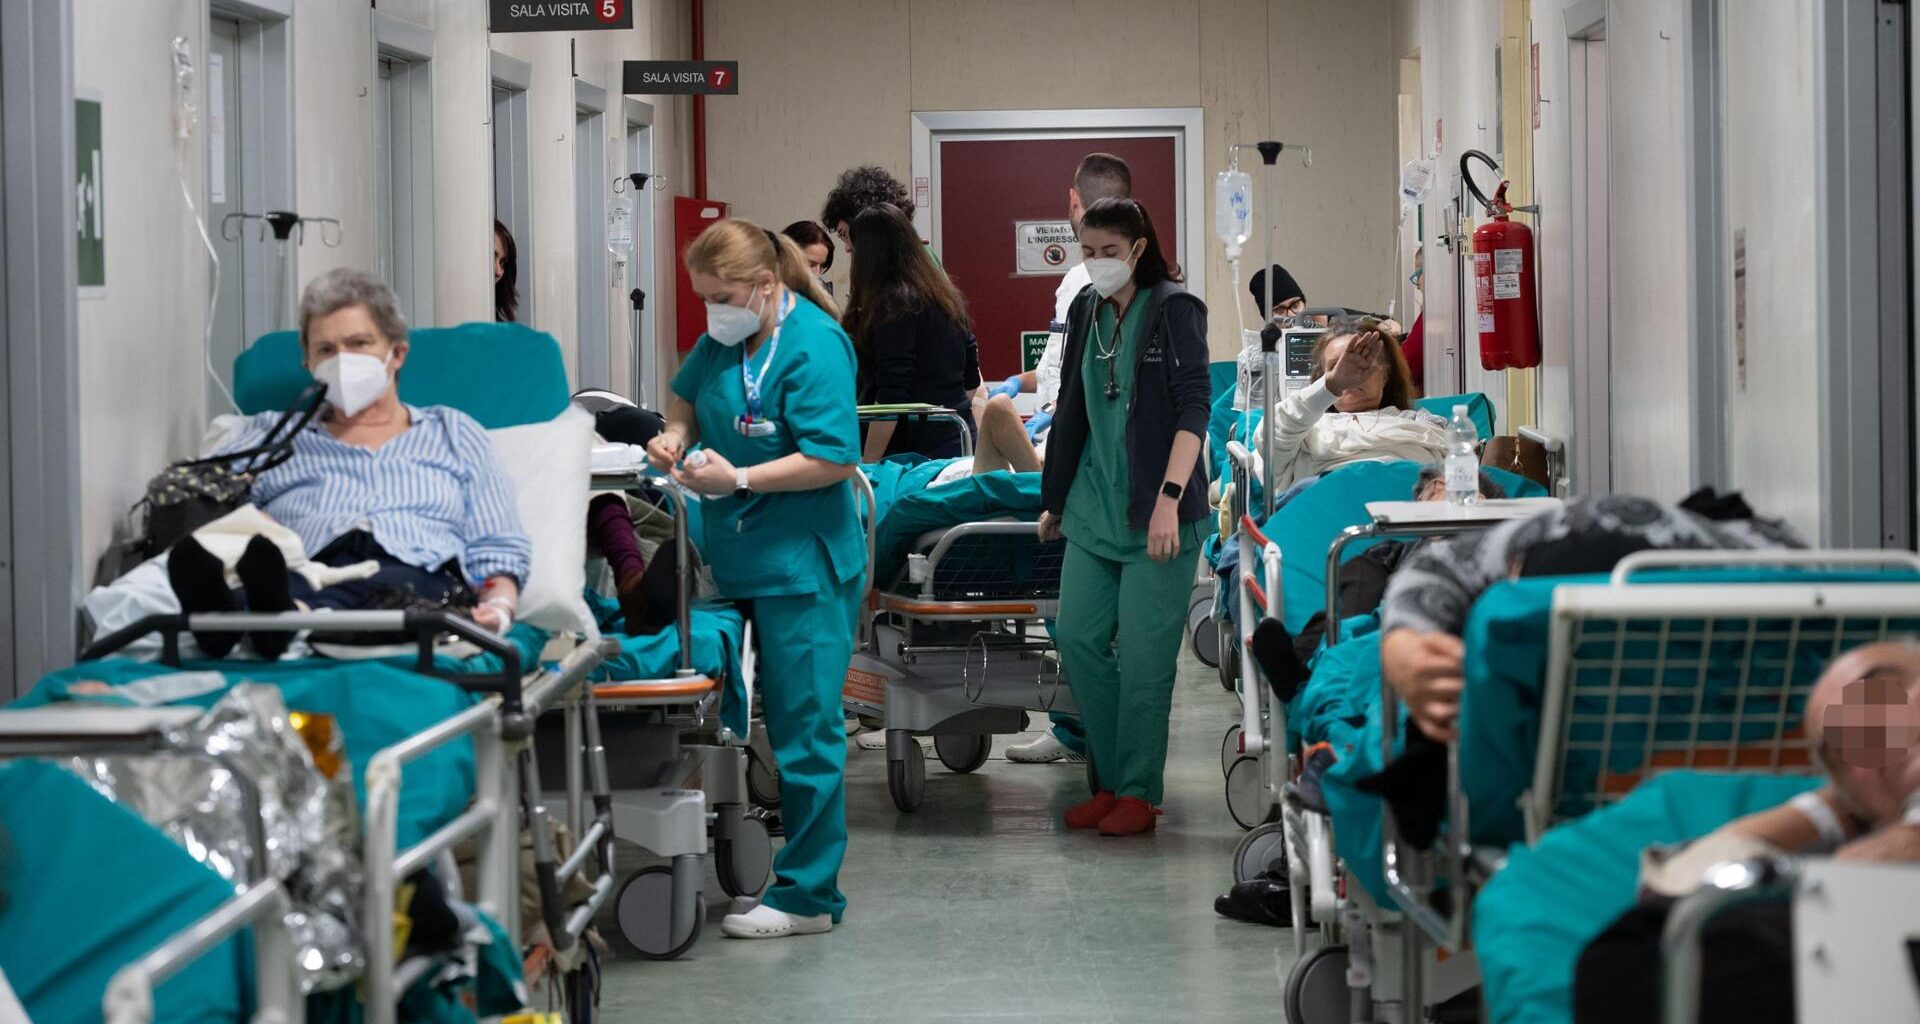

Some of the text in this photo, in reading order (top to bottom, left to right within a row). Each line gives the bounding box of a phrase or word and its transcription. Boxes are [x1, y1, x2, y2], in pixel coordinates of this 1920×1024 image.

[510, 0, 616, 17] SALA VISITA 5
[642, 71, 725, 85] SALA VISITA 7
[1035, 226, 1071, 234] VIETATO
[1028, 236, 1079, 244] L'INGRESSO
